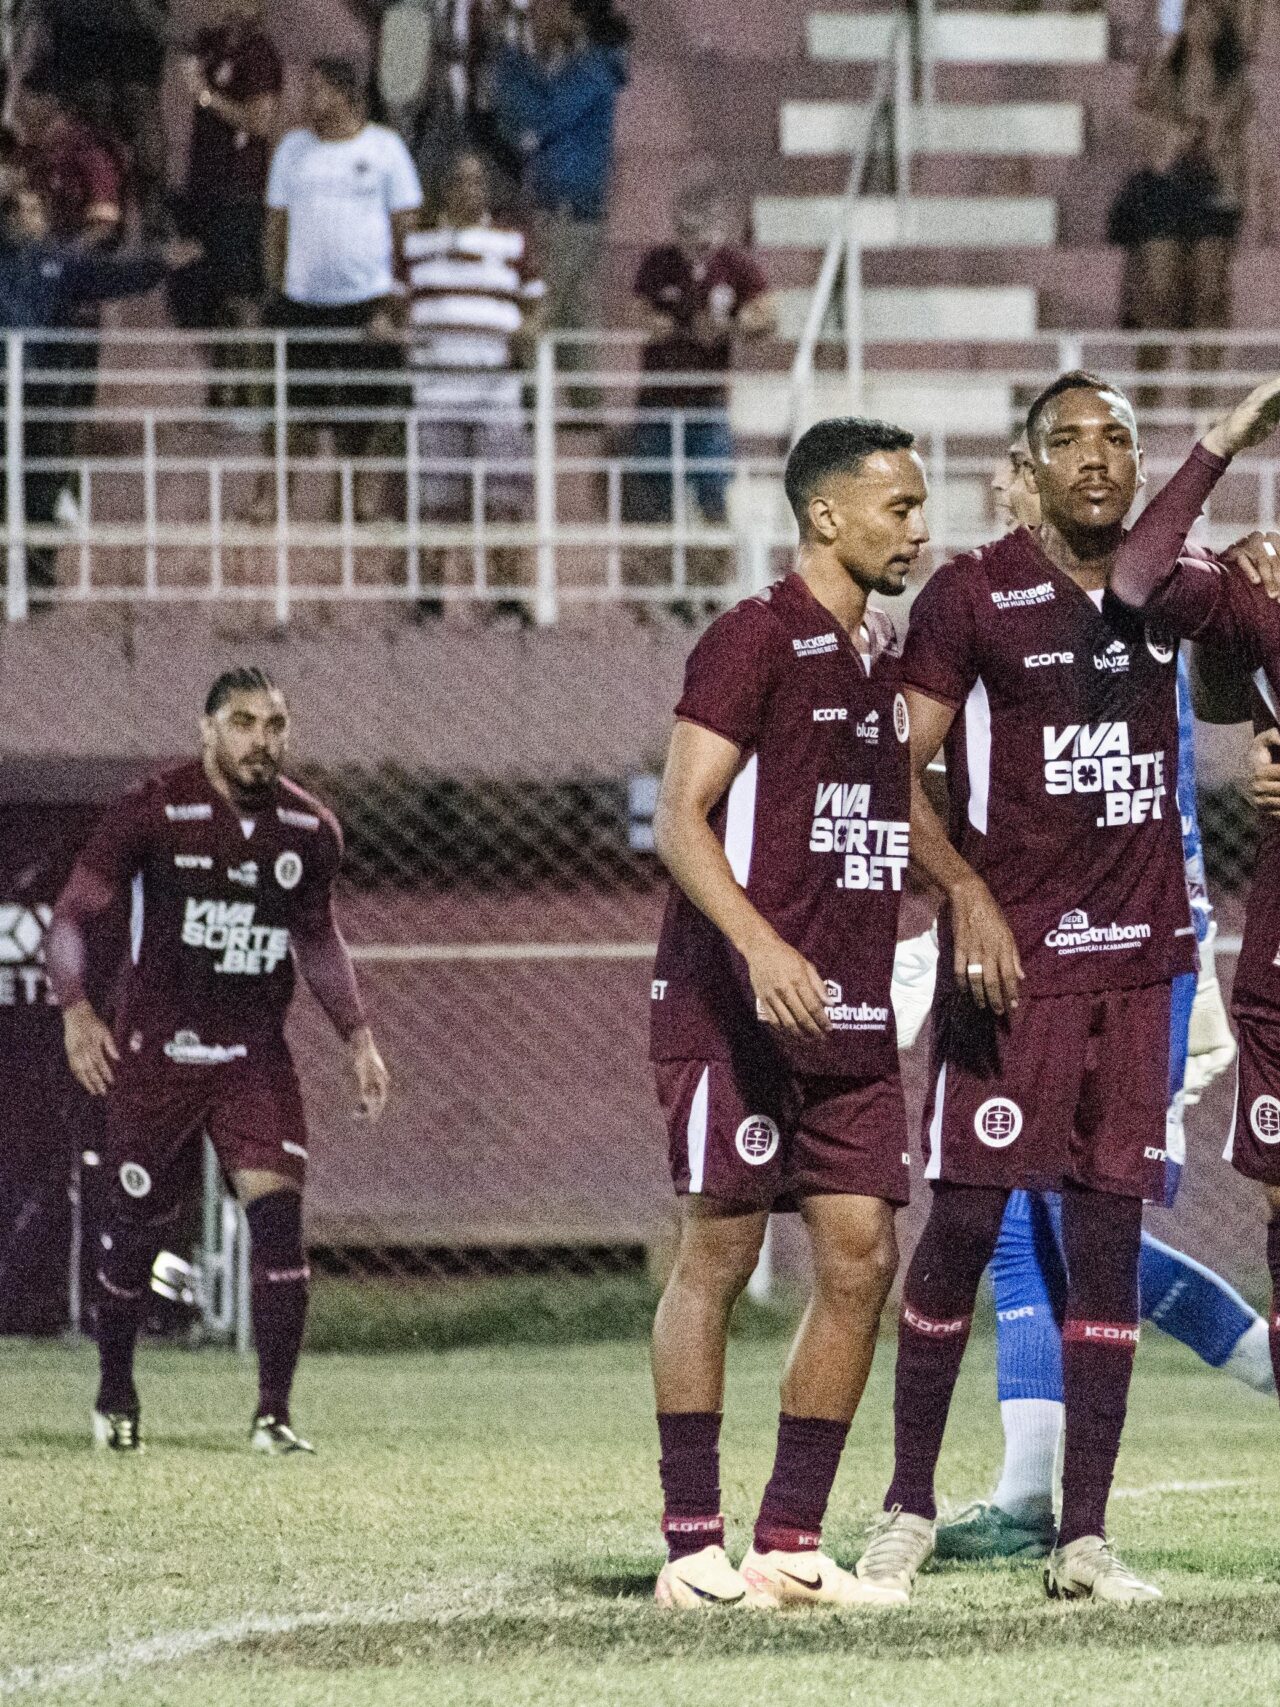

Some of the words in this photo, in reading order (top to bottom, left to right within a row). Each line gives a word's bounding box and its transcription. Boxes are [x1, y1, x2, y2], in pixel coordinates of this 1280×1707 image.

[991, 581, 1055, 603] BLACKBOX
[1094, 654, 1129, 670] bluzz
[856, 722, 879, 738] bluzz
[1044, 751, 1165, 795] SORTE
[814, 783, 871, 818] VIVA
[809, 818, 910, 855] SORTE
[836, 855, 908, 891] .BET
[182, 921, 290, 953] SORTE
[1045, 922, 1150, 947] Construbom
